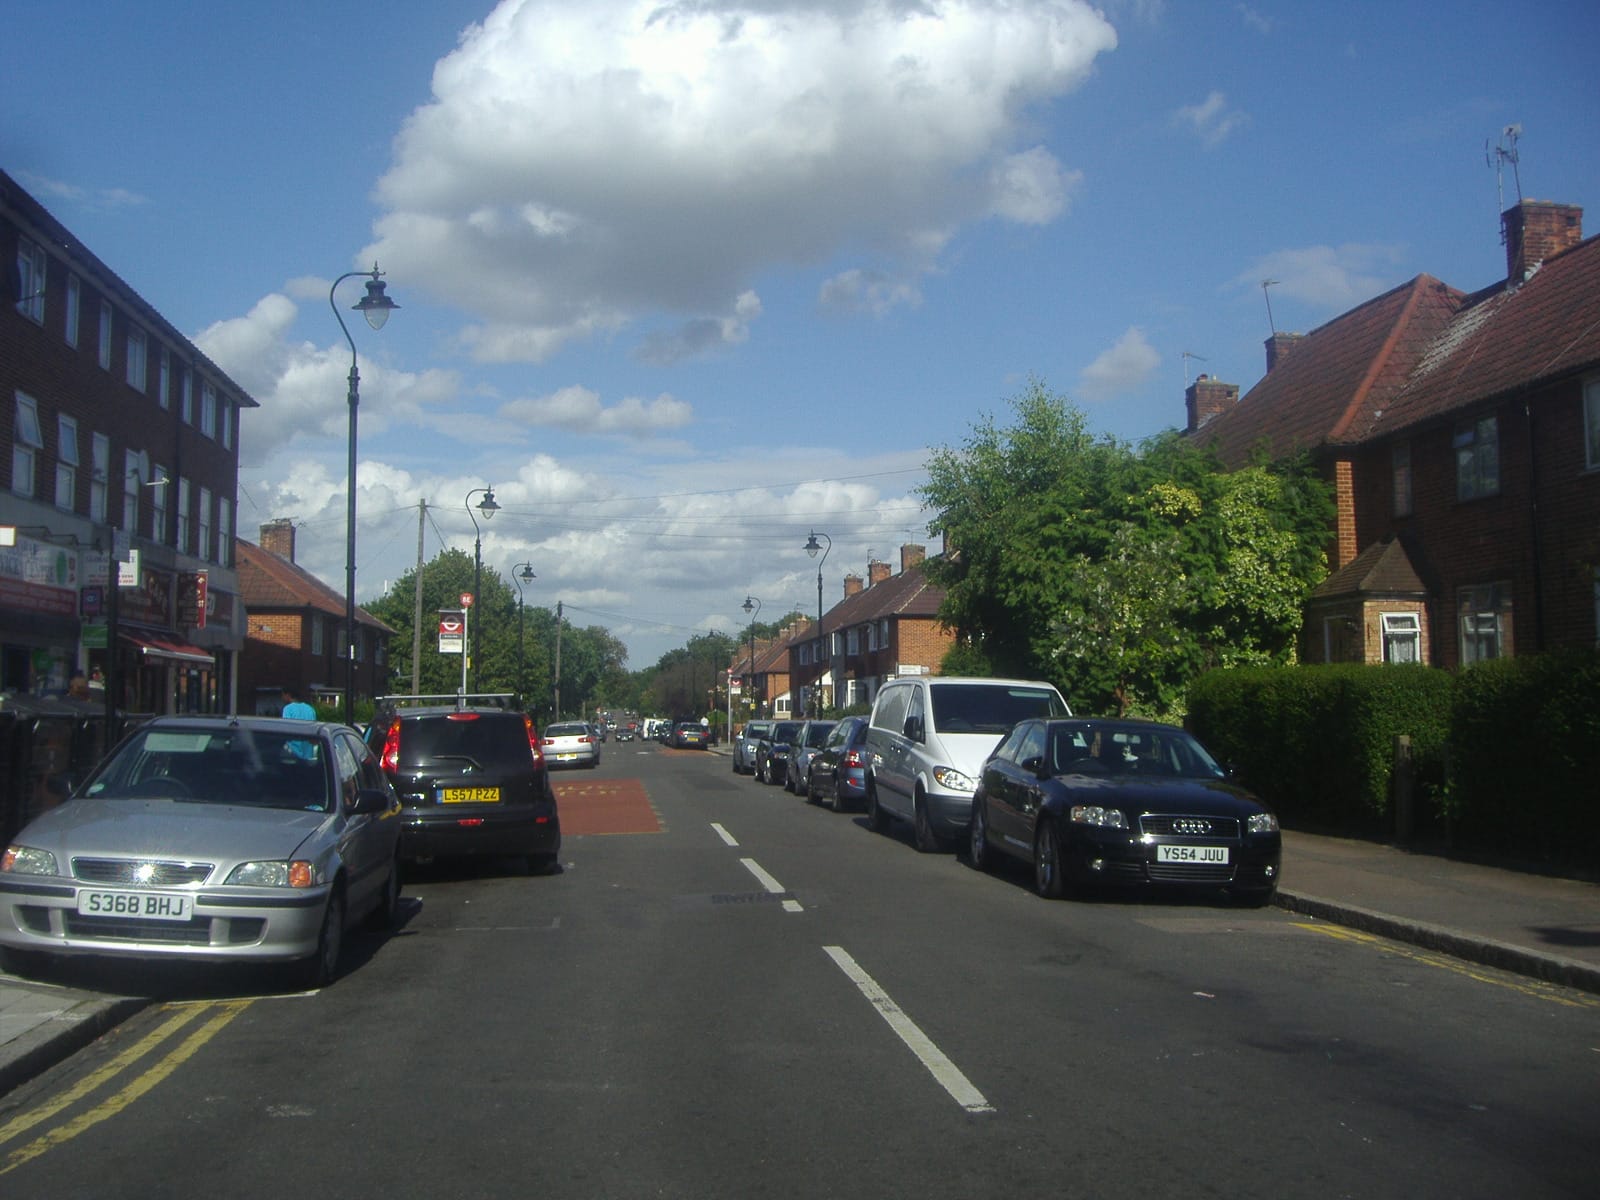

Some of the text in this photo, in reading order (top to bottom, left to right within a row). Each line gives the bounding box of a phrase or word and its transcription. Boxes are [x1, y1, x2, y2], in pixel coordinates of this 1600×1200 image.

[444, 788, 497, 801] LS57 PZZ
[1163, 847, 1224, 862] YS54 JUU
[89, 893, 184, 916] S368 BHJ
